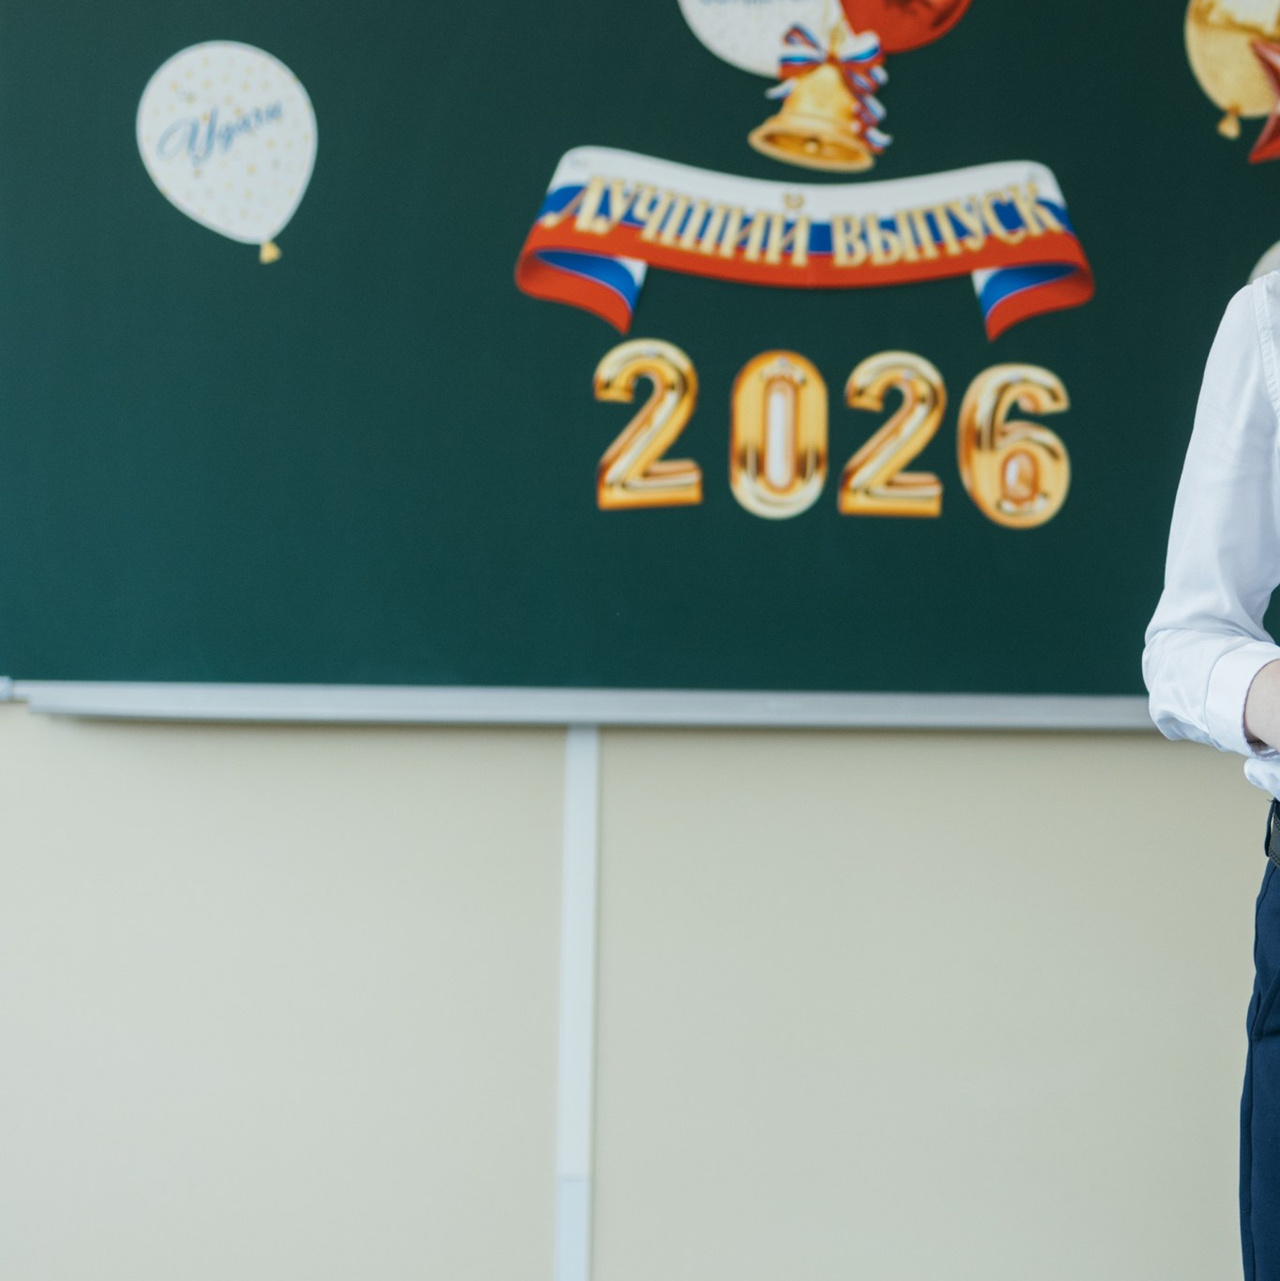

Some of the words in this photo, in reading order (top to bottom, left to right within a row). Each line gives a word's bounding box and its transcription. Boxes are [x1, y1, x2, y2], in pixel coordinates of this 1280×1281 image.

[541, 177, 808, 268] ЛУЧШИЙ
[831, 179, 1062, 269] ВЫПУСК
[594, 339, 1070, 530] 2026
